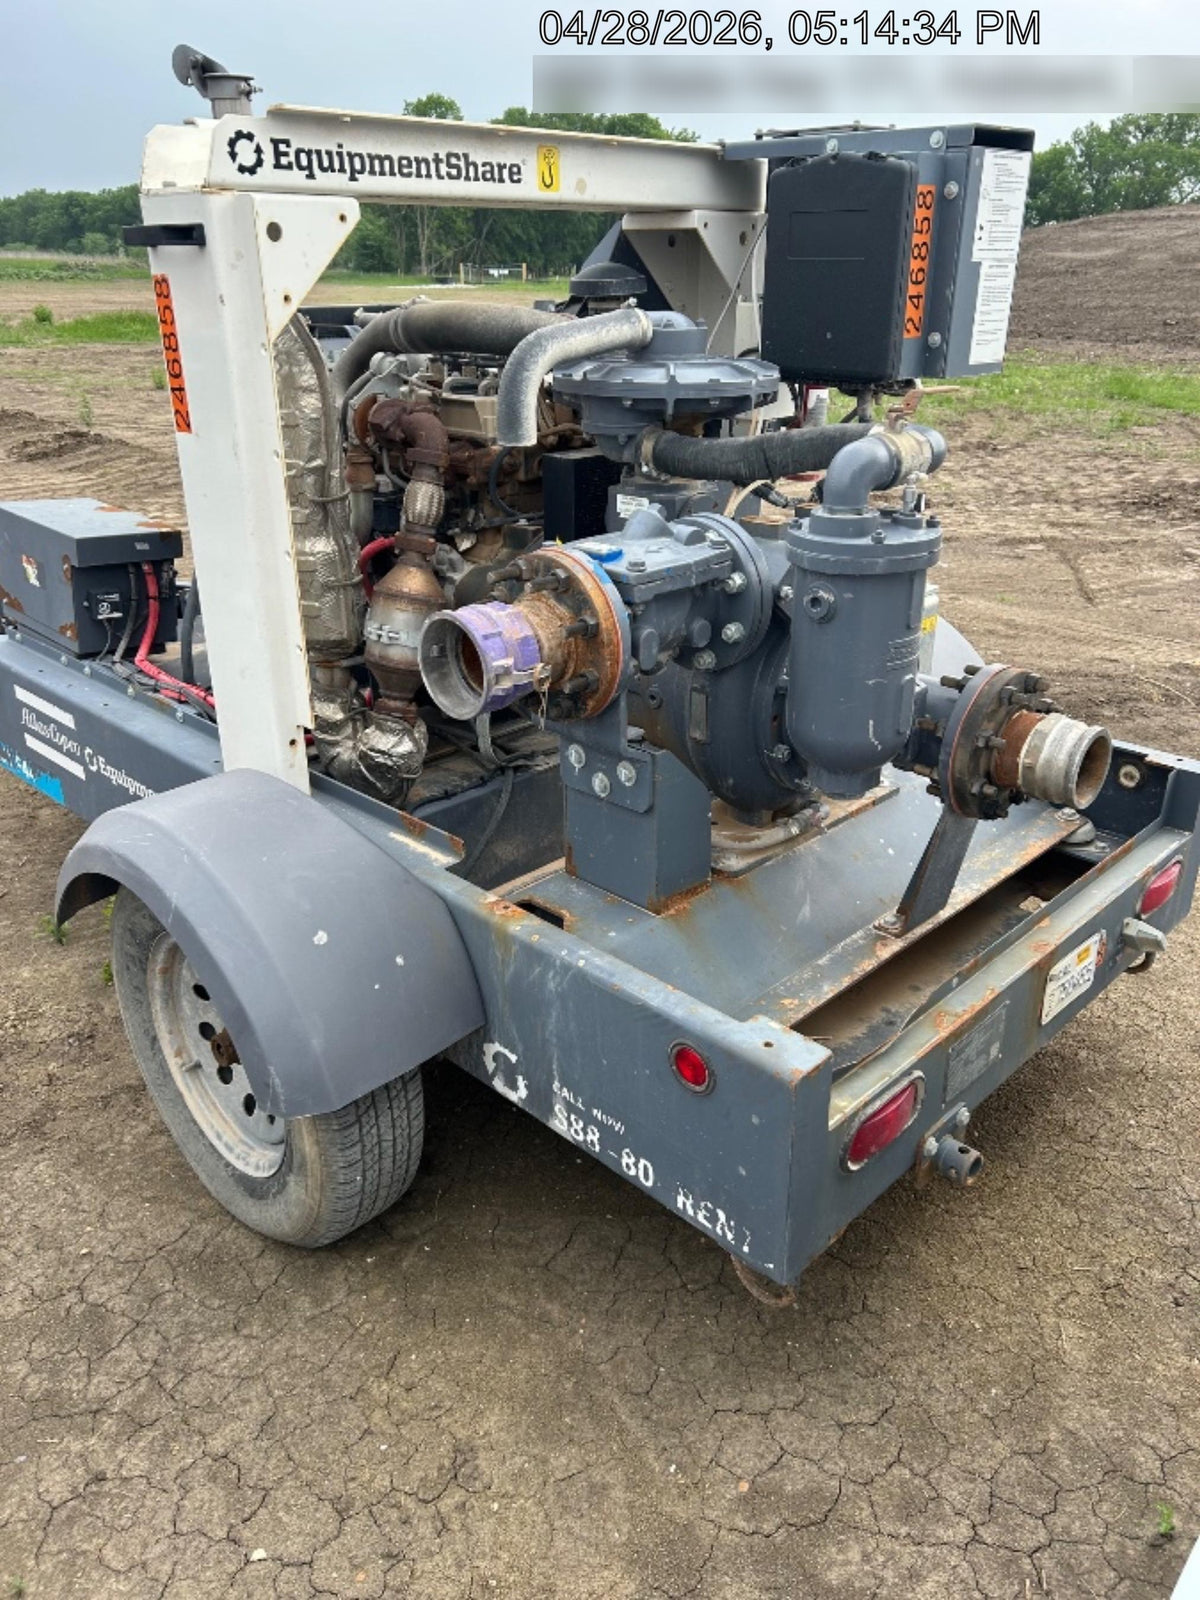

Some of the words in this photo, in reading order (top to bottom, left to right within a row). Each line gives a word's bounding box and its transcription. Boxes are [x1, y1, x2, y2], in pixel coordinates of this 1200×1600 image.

[270, 137, 523, 185] EquipmentShare
[904, 189, 934, 334] 246858
[153, 278, 191, 429] 246858
